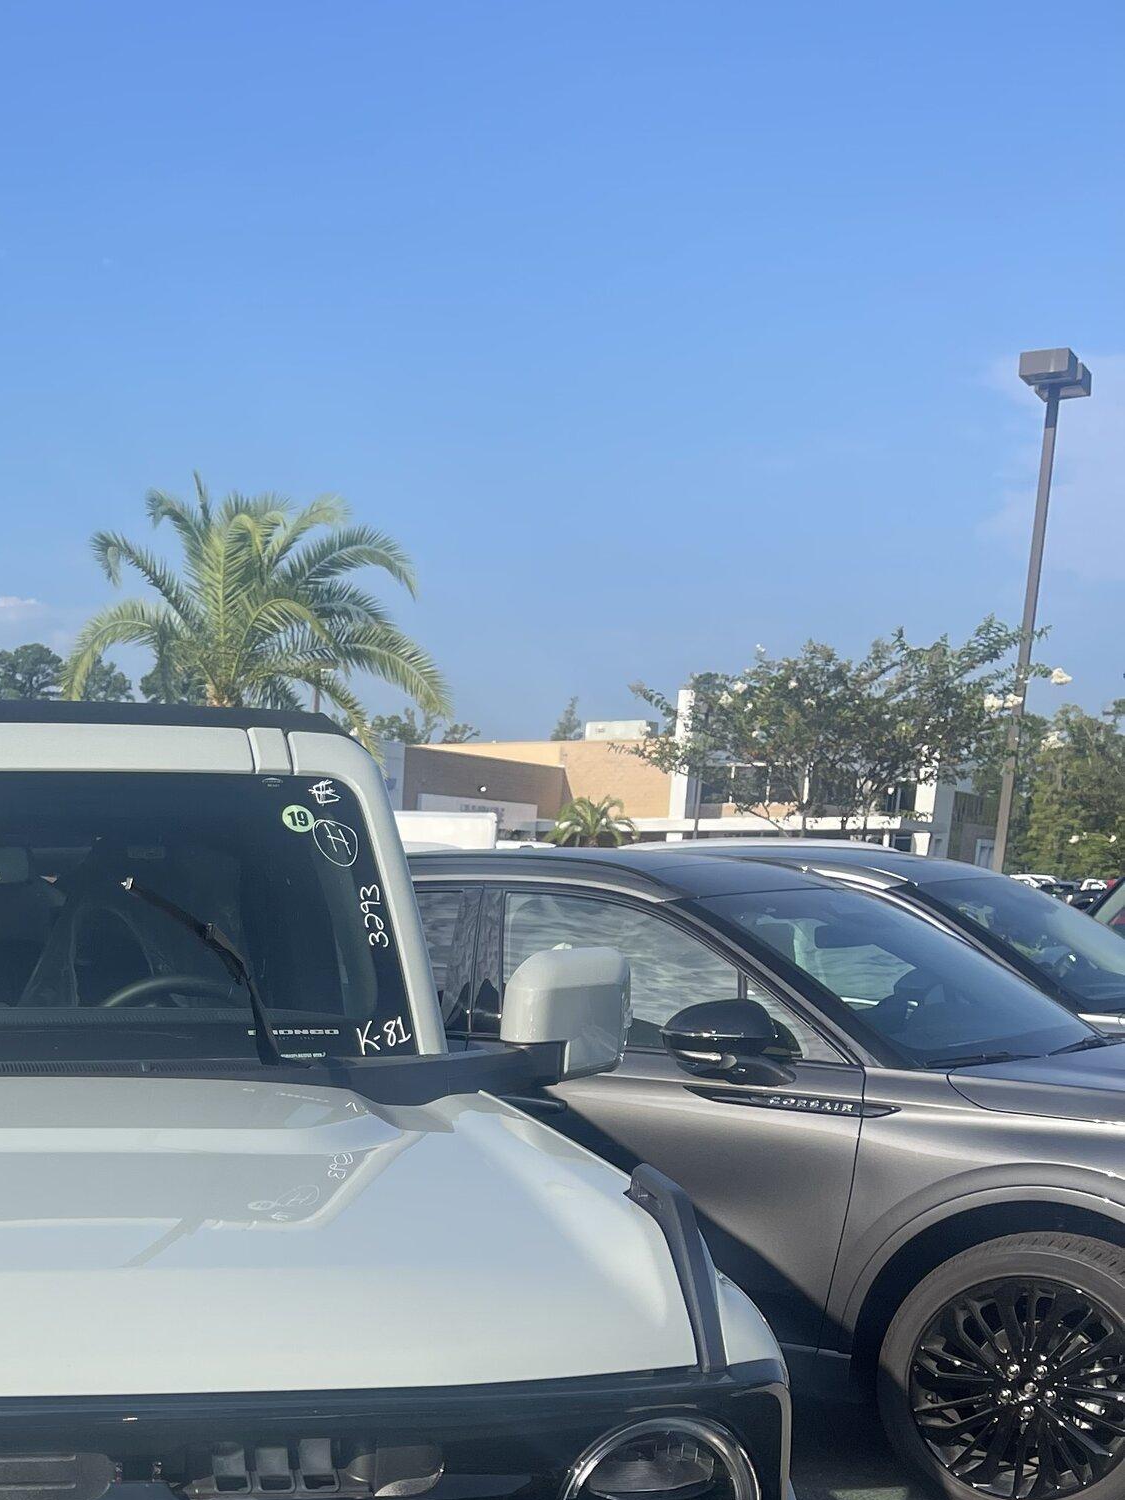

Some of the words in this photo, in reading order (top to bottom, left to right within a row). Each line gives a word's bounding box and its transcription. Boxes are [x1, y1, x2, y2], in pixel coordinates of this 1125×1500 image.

[287, 810, 309, 827] 19
[360, 884, 389, 948] 3293
[356, 1016, 412, 1056] K-81
[769, 1096, 853, 1112] CORSAIR
